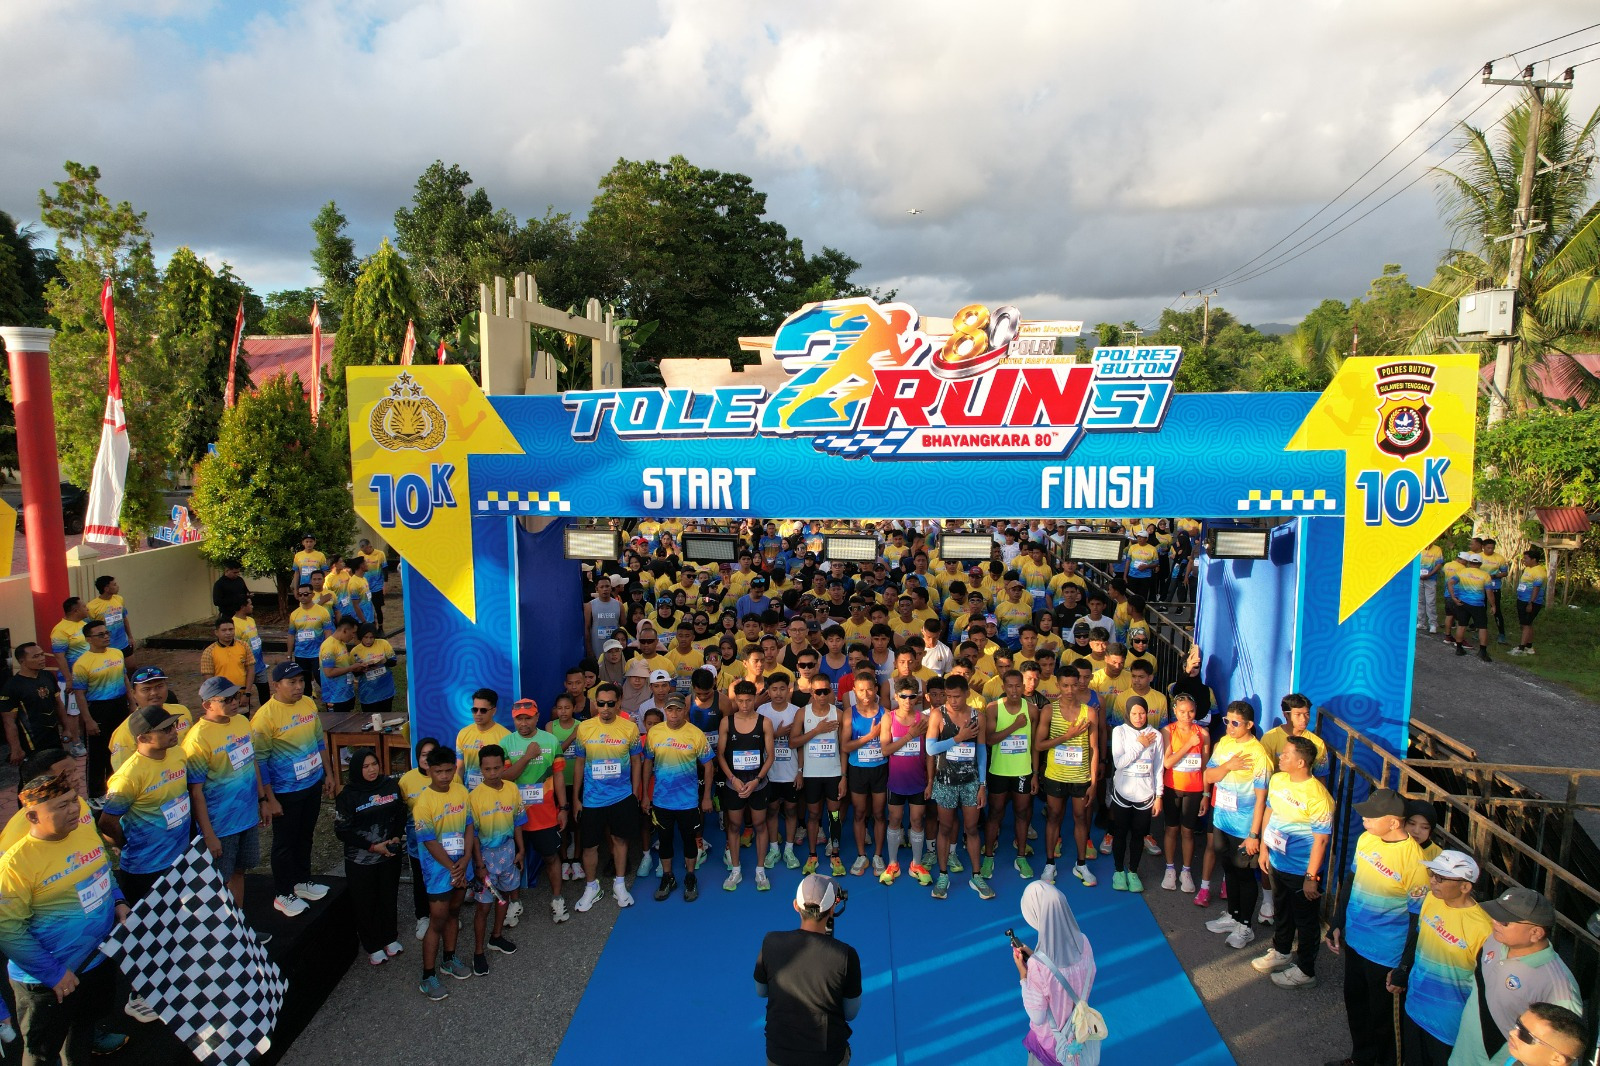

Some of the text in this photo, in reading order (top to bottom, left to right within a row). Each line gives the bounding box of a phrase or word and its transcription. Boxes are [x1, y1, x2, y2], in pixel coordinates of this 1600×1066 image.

[942, 304, 1021, 361] 80
[1008, 339, 1056, 355] POLRI
[1095, 349, 1179, 362] POLRES
[1100, 362, 1172, 375] BUTON
[1381, 365, 1431, 377] POLRES BUTON
[1380, 382, 1431, 393] SULAWESI TENGGARA
[563, 387, 768, 440] TOLE
[860, 368, 1094, 427] RUN
[1086, 382, 1173, 426] SI
[922, 433, 1030, 448] BHAYANGKARA
[643, 467, 756, 510] START
[1041, 466, 1155, 509] FINISH
[1355, 457, 1452, 527] 10K
[369, 463, 458, 530] 10K
[241, 746, 250, 756] VIP
[80, 845, 102, 865] RUN
[1374, 861, 1394, 877] RUN
[99, 878, 109, 891] VIP
[1436, 925, 1460, 944] RUN
